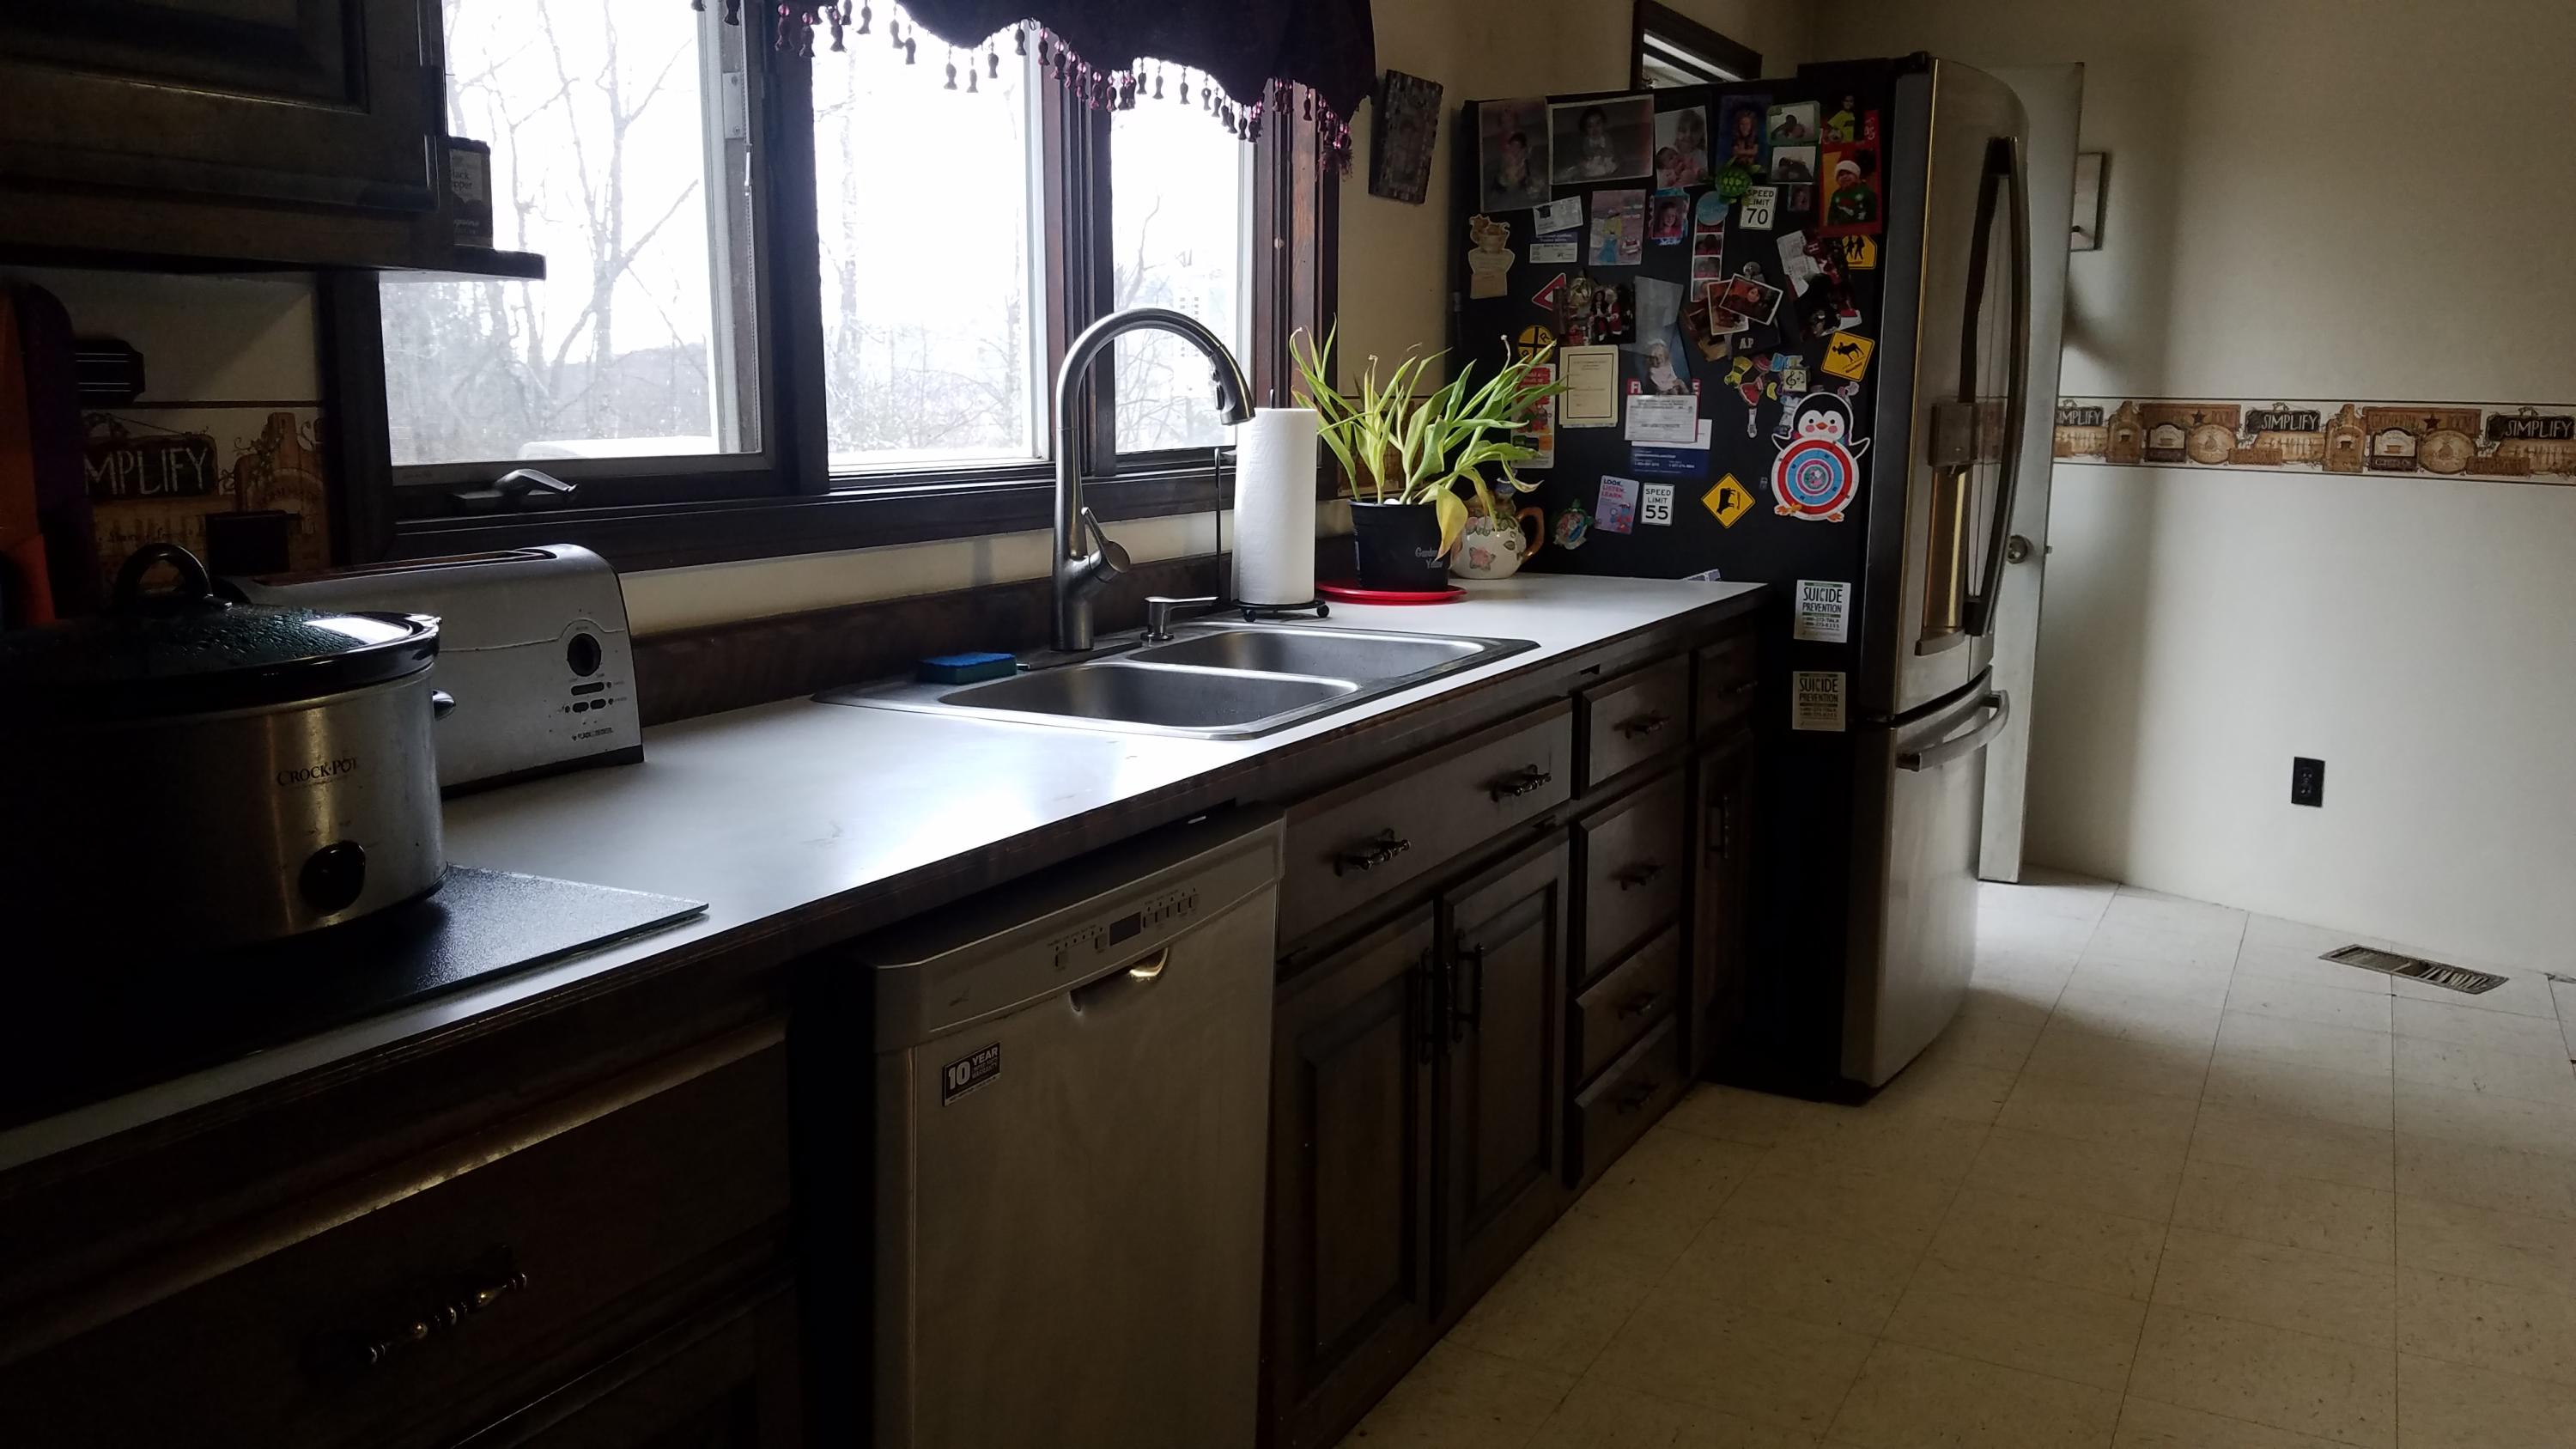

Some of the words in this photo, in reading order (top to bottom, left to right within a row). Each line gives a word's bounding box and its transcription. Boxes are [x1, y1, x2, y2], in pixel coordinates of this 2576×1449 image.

[1746, 189, 1774, 198] SPEED
[1747, 208, 1769, 225] 70
[2261, 414, 2318, 430] SIMPLIFY
[2505, 419, 2573, 439] SIMPLIFY
[1645, 488, 1672, 496] SPEED
[1645, 504, 1669, 520] 55
[1803, 586, 1843, 603] SUICIDE
[1802, 602, 1842, 613] PREVENTION
[1799, 678, 1838, 692] SUICIDE
[1799, 692, 1838, 703] PREVENTION
[948, 1061, 971, 1091] 10
[972, 1046, 999, 1066] YEAR
